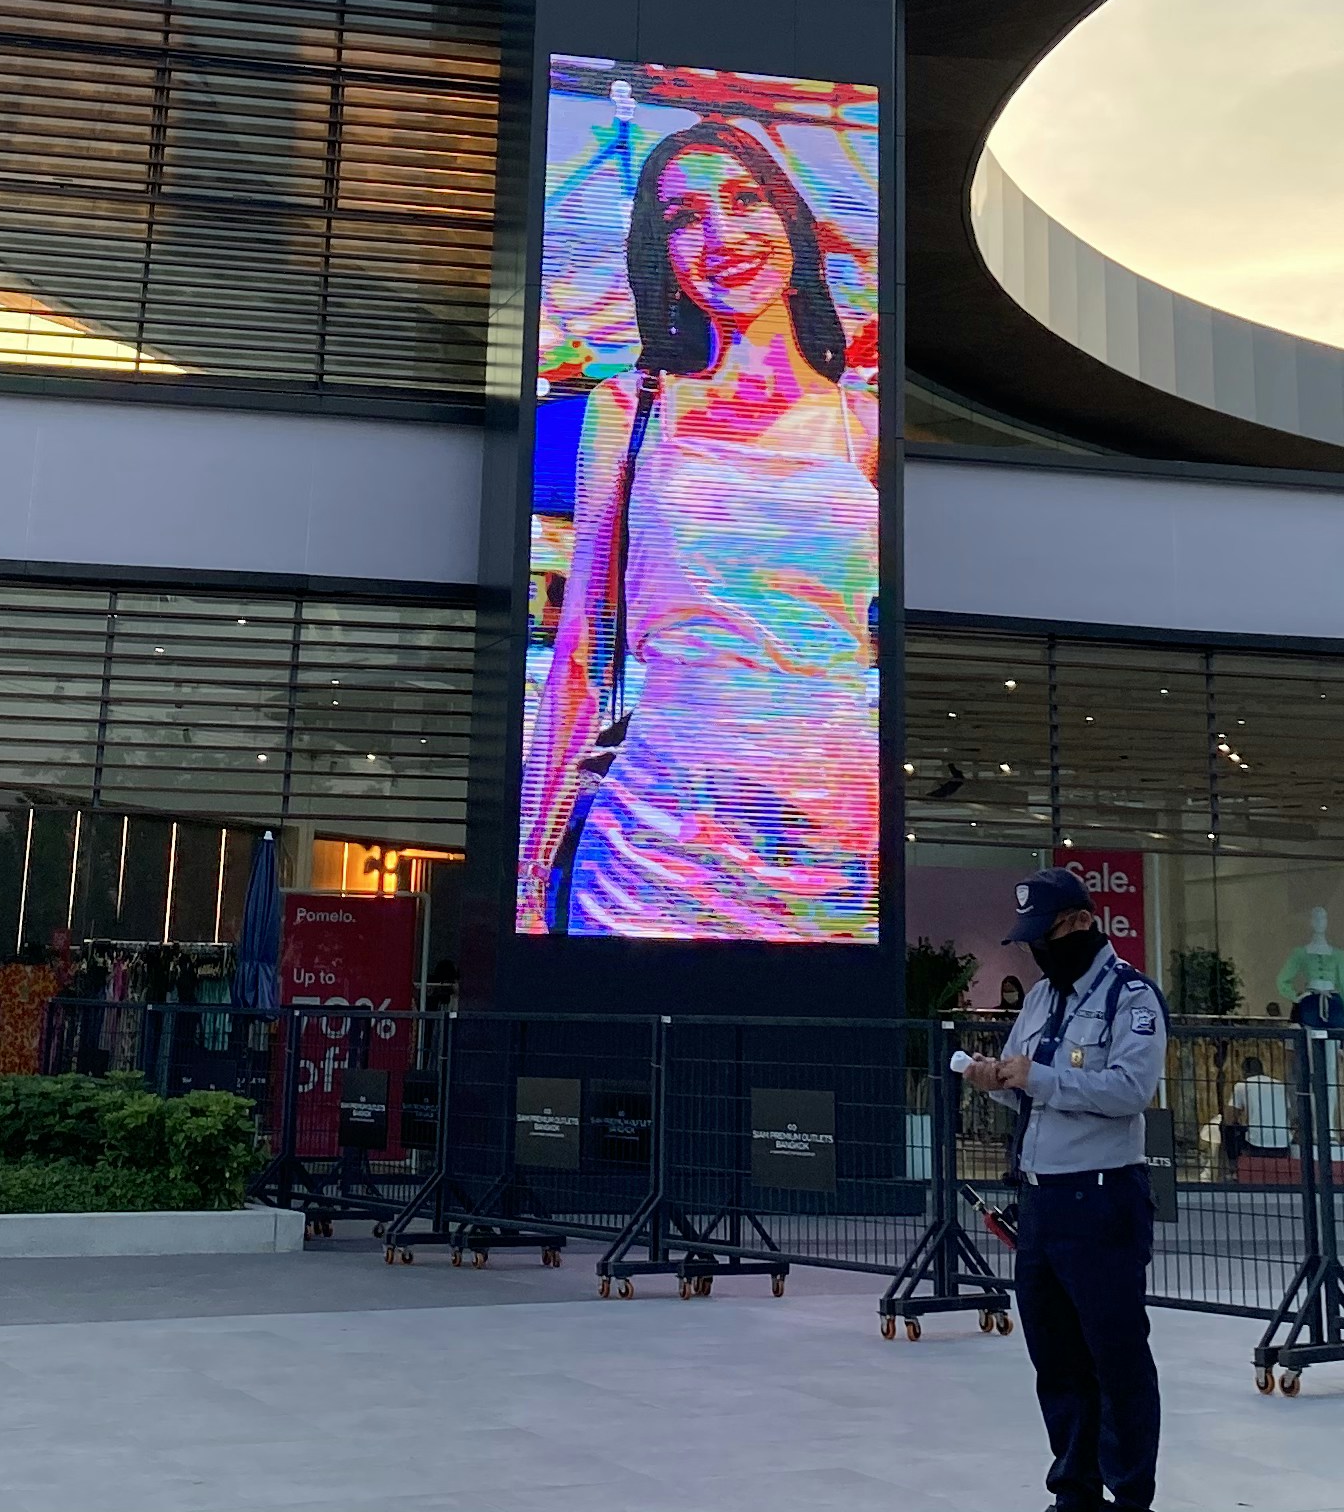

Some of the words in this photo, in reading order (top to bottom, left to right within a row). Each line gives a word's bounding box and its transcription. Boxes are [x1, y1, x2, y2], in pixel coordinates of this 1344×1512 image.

[296, 907, 356, 924] Pomelo.
[293, 968, 315, 987] Up
[319, 970, 336, 985] to
